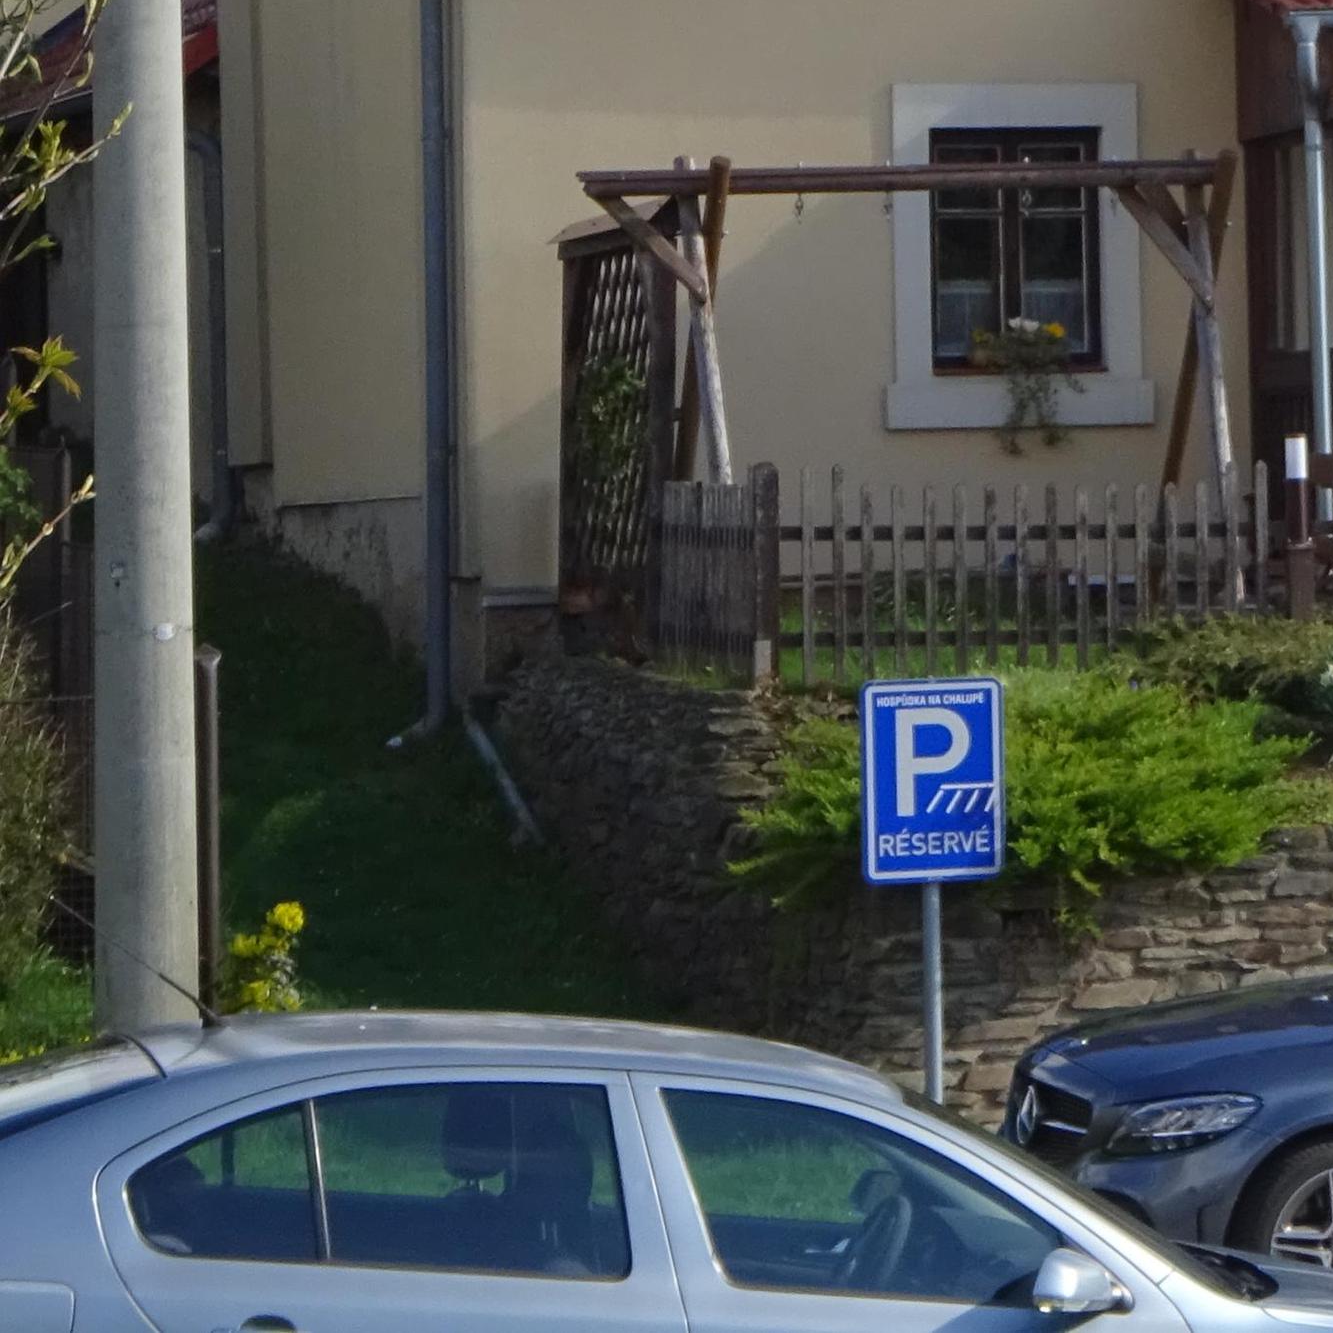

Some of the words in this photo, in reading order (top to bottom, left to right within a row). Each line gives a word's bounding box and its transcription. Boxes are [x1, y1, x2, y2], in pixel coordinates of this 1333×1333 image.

[927, 694, 942, 705] NA
[895, 707, 971, 817] P
[879, 825, 991, 858] RÉSERVÉ
